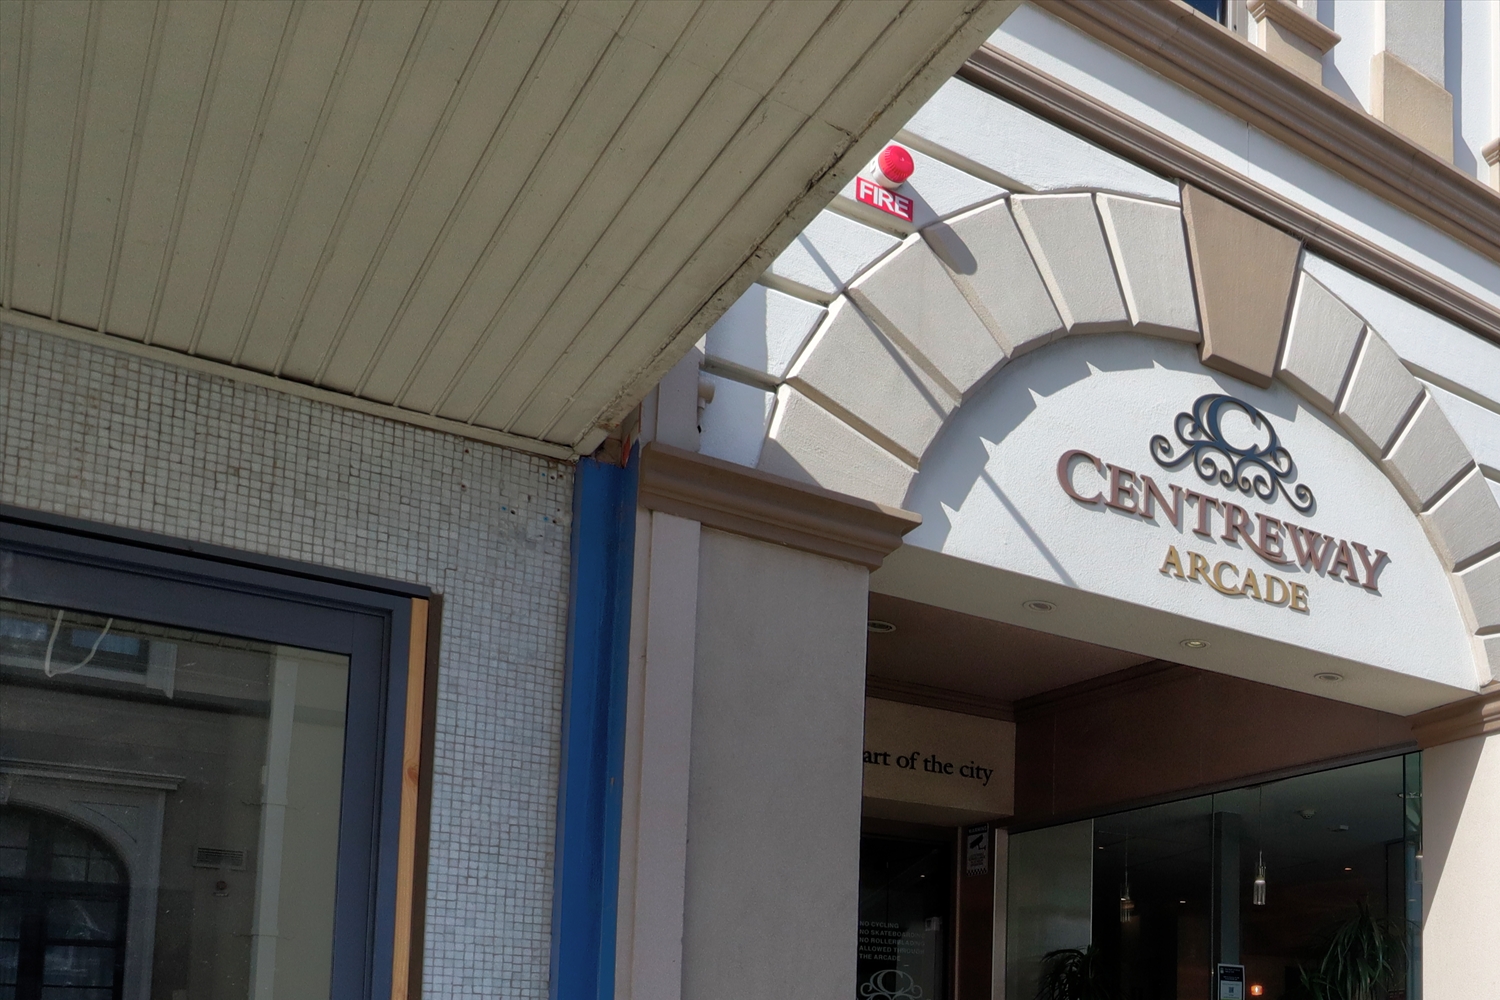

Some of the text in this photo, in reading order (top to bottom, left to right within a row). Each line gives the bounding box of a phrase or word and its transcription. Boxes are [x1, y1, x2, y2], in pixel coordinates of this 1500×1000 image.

[860, 180, 909, 218] FIRE
[1057, 449, 1388, 591] CENTREWAY
[1159, 545, 1309, 612] ARCADE
[896, 751, 920, 770] of
[923, 755, 954, 775] the
[960, 761, 993, 787] city
[871, 921, 899, 929] CYCLING
[859, 945, 892, 953] ALLOWED
